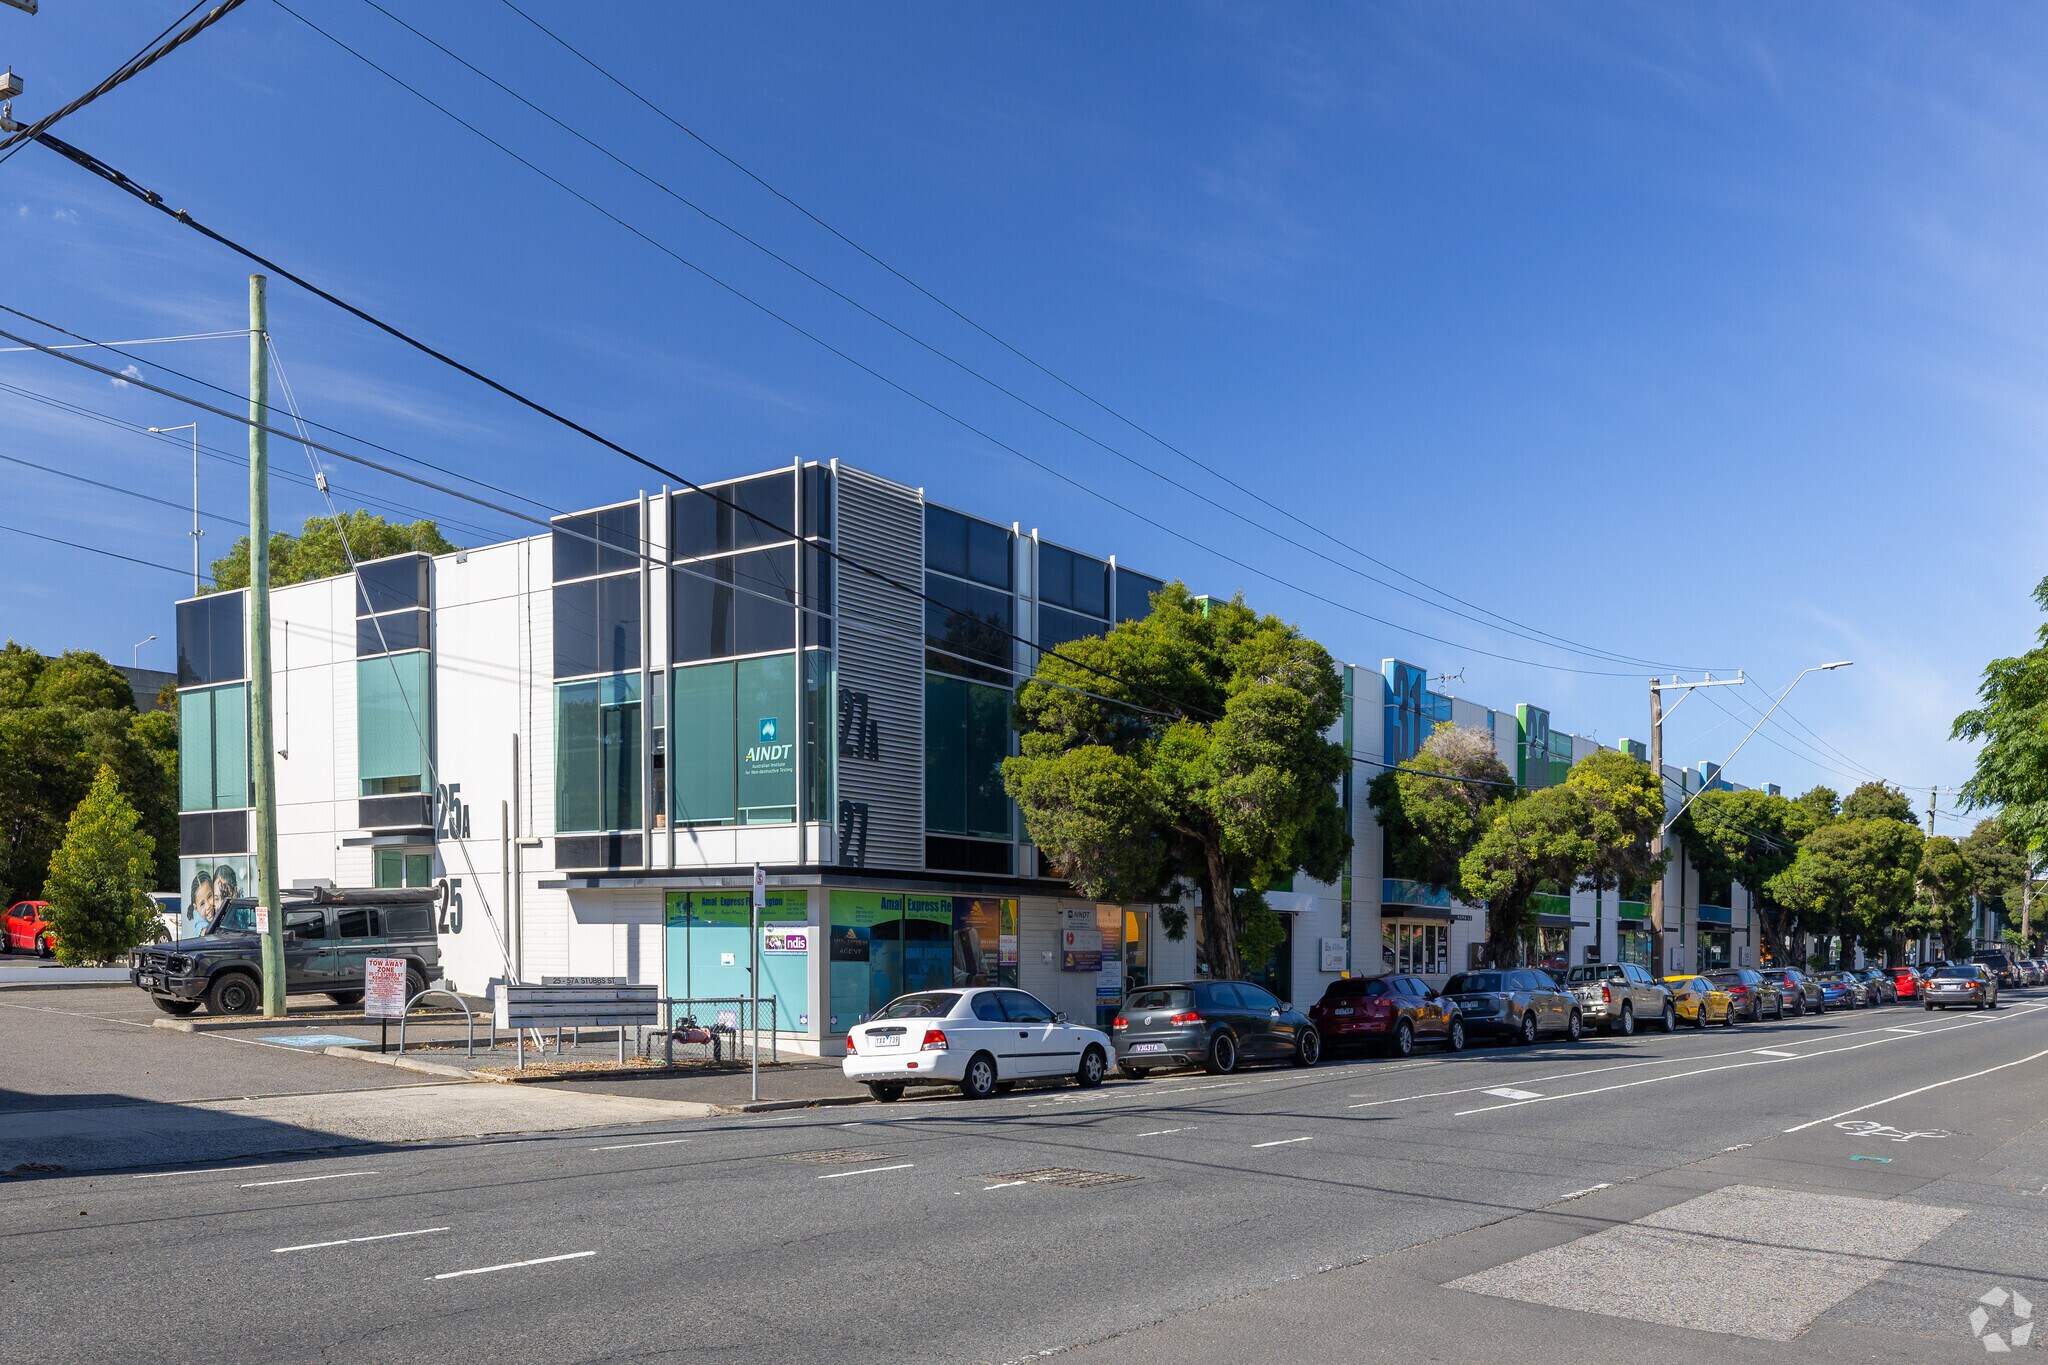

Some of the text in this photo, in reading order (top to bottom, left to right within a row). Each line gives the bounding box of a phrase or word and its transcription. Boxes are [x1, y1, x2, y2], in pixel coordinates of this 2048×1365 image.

[745, 744, 793, 762] AINDT
[437, 783, 471, 840] 25A
[839, 800, 869, 868] 27
[438, 878, 464, 934] 25
[701, 896, 718, 907] Amal
[720, 896, 745, 908] Express
[881, 896, 903, 911] Amal
[908, 898, 940, 913] Express
[787, 936, 806, 949] ndis
[552, 977, 562, 985] 25
[580, 977, 606, 985] STUBBS
